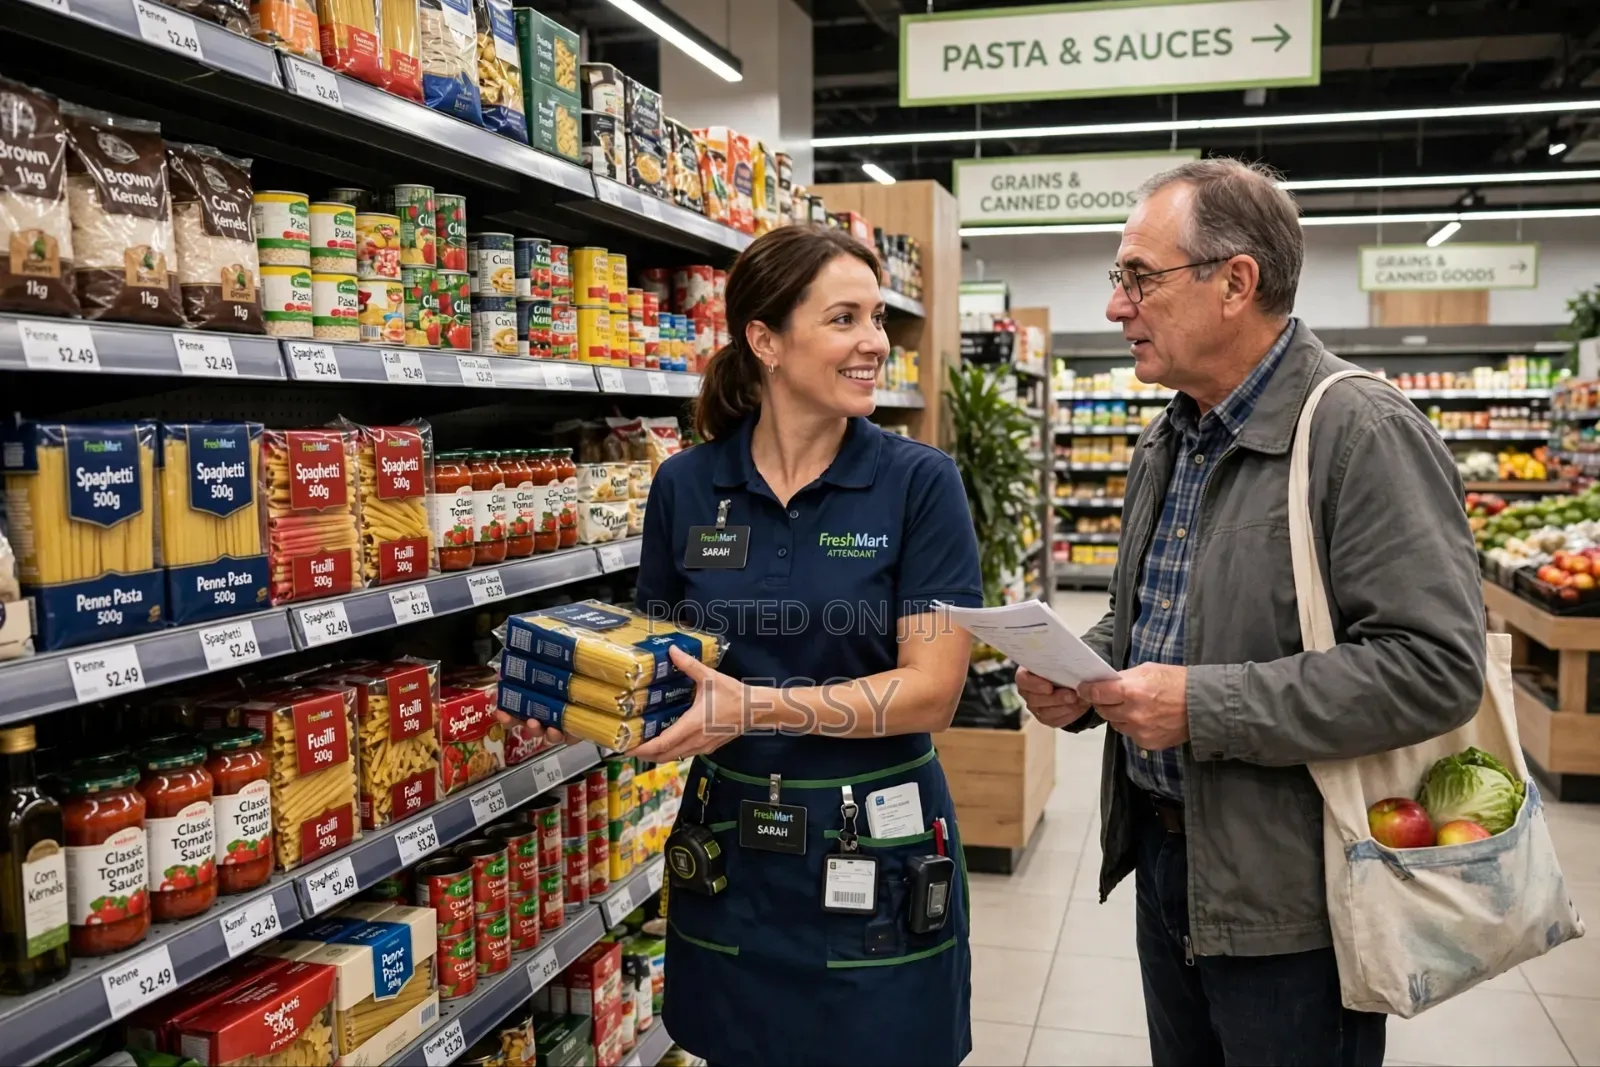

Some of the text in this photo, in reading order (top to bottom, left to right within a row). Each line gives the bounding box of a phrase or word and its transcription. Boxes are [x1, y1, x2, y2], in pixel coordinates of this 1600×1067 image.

[138, 4, 168, 25] Penne
[167, 30, 198, 53] $2.49
[943, 28, 1232, 72] PASTA & SAUCES
[294, 64, 317, 81] Penne
[316, 85, 339, 103] $2.49
[15, 166, 47, 190] 1kg
[103, 167, 153, 189] Brown
[991, 172, 1081, 192] GRAINS &
[111, 189, 158, 210] Kernels
[211, 194, 240, 214] Corn
[980, 191, 1137, 213] CANNED GOODS
[211, 212, 248, 233] Kernels
[1377, 255, 1432, 269] GRAINS
[1375, 268, 1496, 284] CANNED GOODS
[26, 280, 49, 300] 1kg
[140, 291, 160, 309] 1kg
[233, 305, 249, 322] 1kg
[24, 327, 60, 342] Penne
[59, 347, 94, 364] $2.49
[179, 340, 205, 353] Penne
[204, 356, 233, 371] $2.49
[315, 361, 337, 376] $2.49
[402, 366, 423, 379] $2.49
[84, 440, 123, 453] FreshMart
[203, 438, 237, 450] FreshMart
[302, 442, 331, 453] FreshMart
[387, 438, 411, 449] FreshMart
[197, 462, 246, 486] Spaghetti
[296, 463, 341, 485] Spaghetti
[382, 456, 419, 477] Spaghetti
[76, 466, 134, 493] Spaghetti
[393, 478, 411, 492] 500g
[93, 491, 121, 510] 500g
[211, 484, 234, 502] 500g
[308, 485, 330, 500] 500g
[700, 533, 737, 544] FreshMart
[819, 533, 889, 548] FreshMart
[394, 545, 414, 561] Fusilli
[702, 548, 729, 557] SARAH
[827, 550, 877, 559] ATTENDANT
[310, 558, 335, 575] Fusilli
[397, 561, 413, 574] 500g
[197, 571, 253, 592] Penne Pasta
[314, 576, 333, 588] 500g
[76, 588, 143, 612] Penne Pasta
[214, 590, 236, 605] 500g
[487, 585, 504, 598] $3.29
[97, 608, 123, 626] 500g
[411, 601, 430, 615] $3.29
[304, 608, 336, 628] Spaghetti
[204, 627, 243, 649] Spaghetti
[326, 621, 348, 636] $2.49
[230, 641, 256, 659] $2.49
[74, 659, 106, 678] Penne
[106, 667, 139, 688] $2.49
[398, 682, 420, 696] FreshMart
[307, 708, 334, 724] FreshMart
[399, 698, 423, 719] Fusilli
[403, 717, 420, 733] 500g
[307, 727, 336, 750] Fusilli
[314, 747, 333, 764] 500g
[404, 779, 422, 799] Fusilli
[472, 787, 502, 808] Tomato Sauce
[239, 794, 269, 814] Classic
[405, 793, 422, 810] 500g
[489, 798, 505, 812] $3.29
[233, 805, 270, 826] Tomato
[753, 808, 794, 823] FreshMart
[177, 816, 211, 837] Classic
[242, 820, 269, 838] Sauce
[316, 817, 338, 839] Fusilli
[397, 822, 434, 847] Tomato Sauce
[757, 824, 789, 838] SARAH
[172, 829, 213, 852] Tomato
[319, 834, 337, 850] 500g
[417, 837, 436, 856] $3.29
[105, 844, 143, 866] Classic
[181, 844, 212, 863] Sauce
[34, 867, 57, 886] Corn
[98, 858, 145, 881] Tomato
[109, 874, 144, 893] Sauce
[332, 876, 355, 899] $2.49
[28, 881, 64, 906] Kernels
[250, 914, 277, 939] $2.49
[382, 947, 405, 968] Penne
[108, 966, 140, 989] Penne
[139, 967, 172, 995] $2.49
[382, 961, 405, 983] Pasta
[264, 995, 300, 1027] Spaghetti
[273, 1017, 294, 1037] 500g
[426, 1026, 461, 1055] Tomato Sauce
[444, 1037, 463, 1059] $3.29
